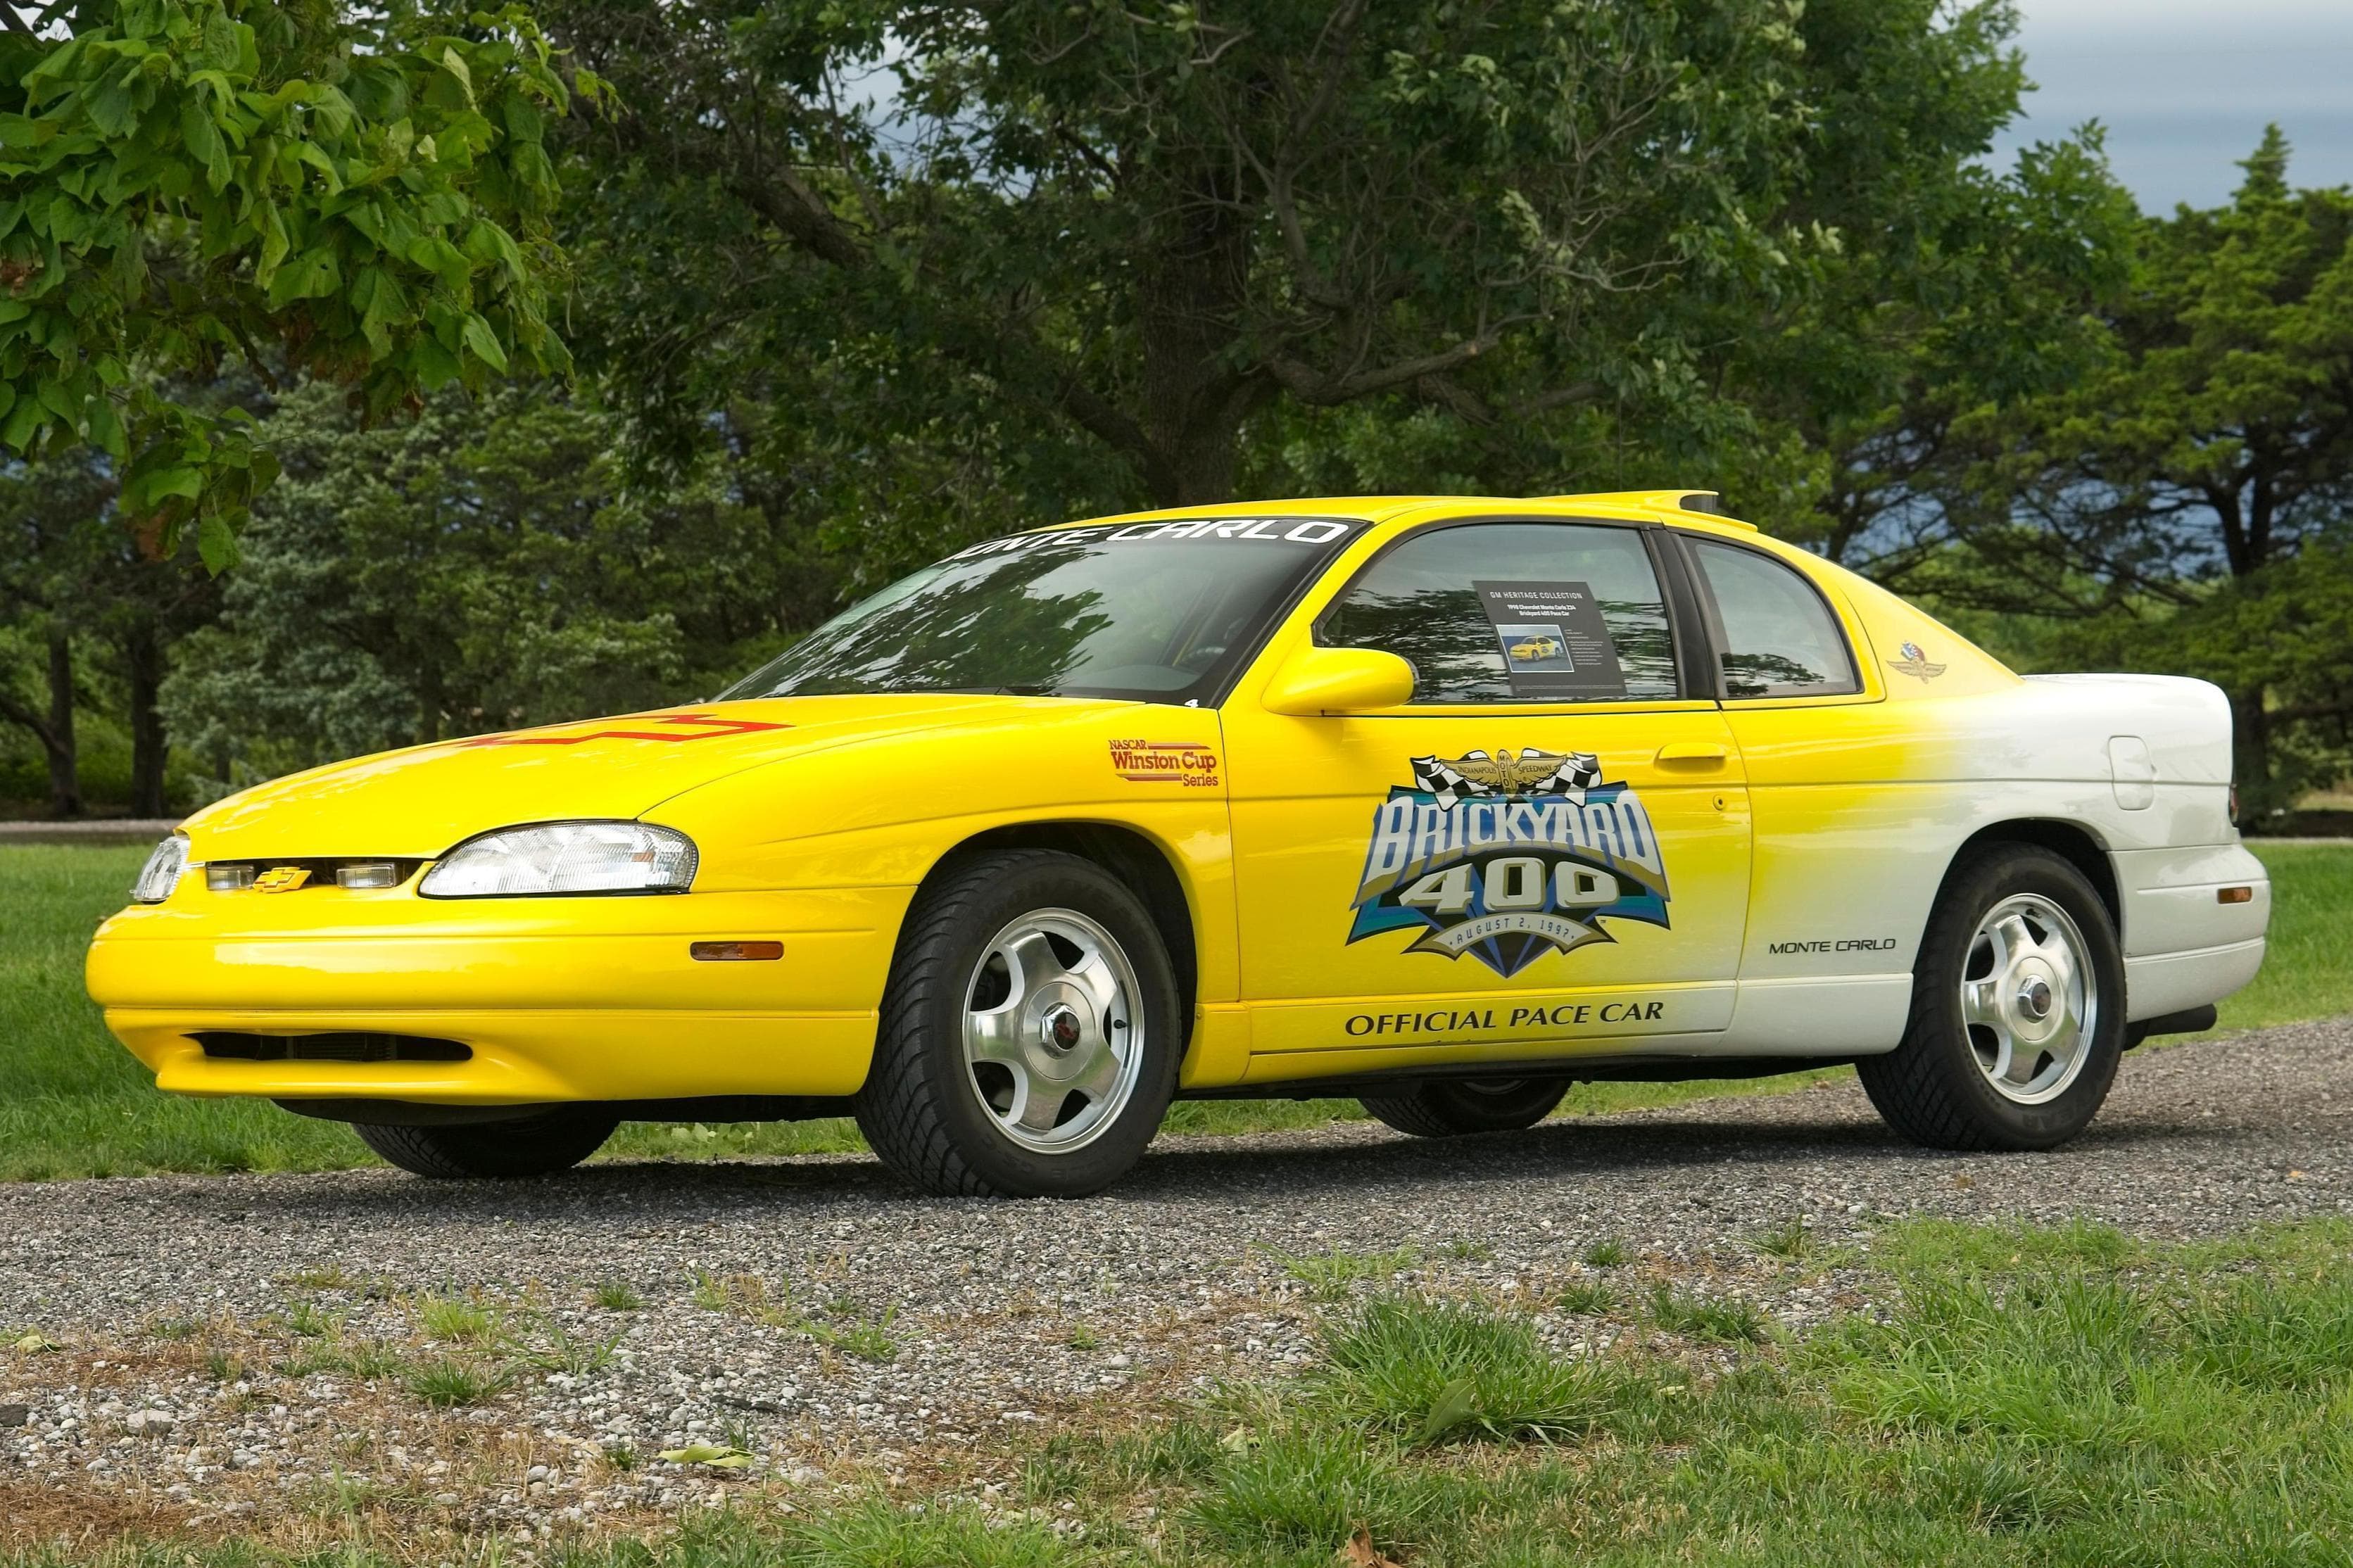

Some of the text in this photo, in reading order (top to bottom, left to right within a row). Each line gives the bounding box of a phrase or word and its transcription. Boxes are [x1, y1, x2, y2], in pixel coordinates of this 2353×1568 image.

[947, 519, 1349, 560] ONTE CARLO
[1109, 739, 1148, 750] NASCAR
[1111, 751, 1217, 773] Winston Cup
[1458, 765, 1498, 774] INDIANAPOLIS
[1518, 765, 1552, 774] SPEEDWAY
[1182, 773, 1219, 787] Series
[1499, 755, 1511, 795] MOTOR
[1358, 788, 1665, 888] BRICKYARD
[1398, 856, 1620, 913] 400
[1456, 918, 1510, 944] AUGUST
[1770, 939, 1896, 954] MONTE CARLO
[1345, 1001, 1664, 1036] OFFICIAL PACE CAR
